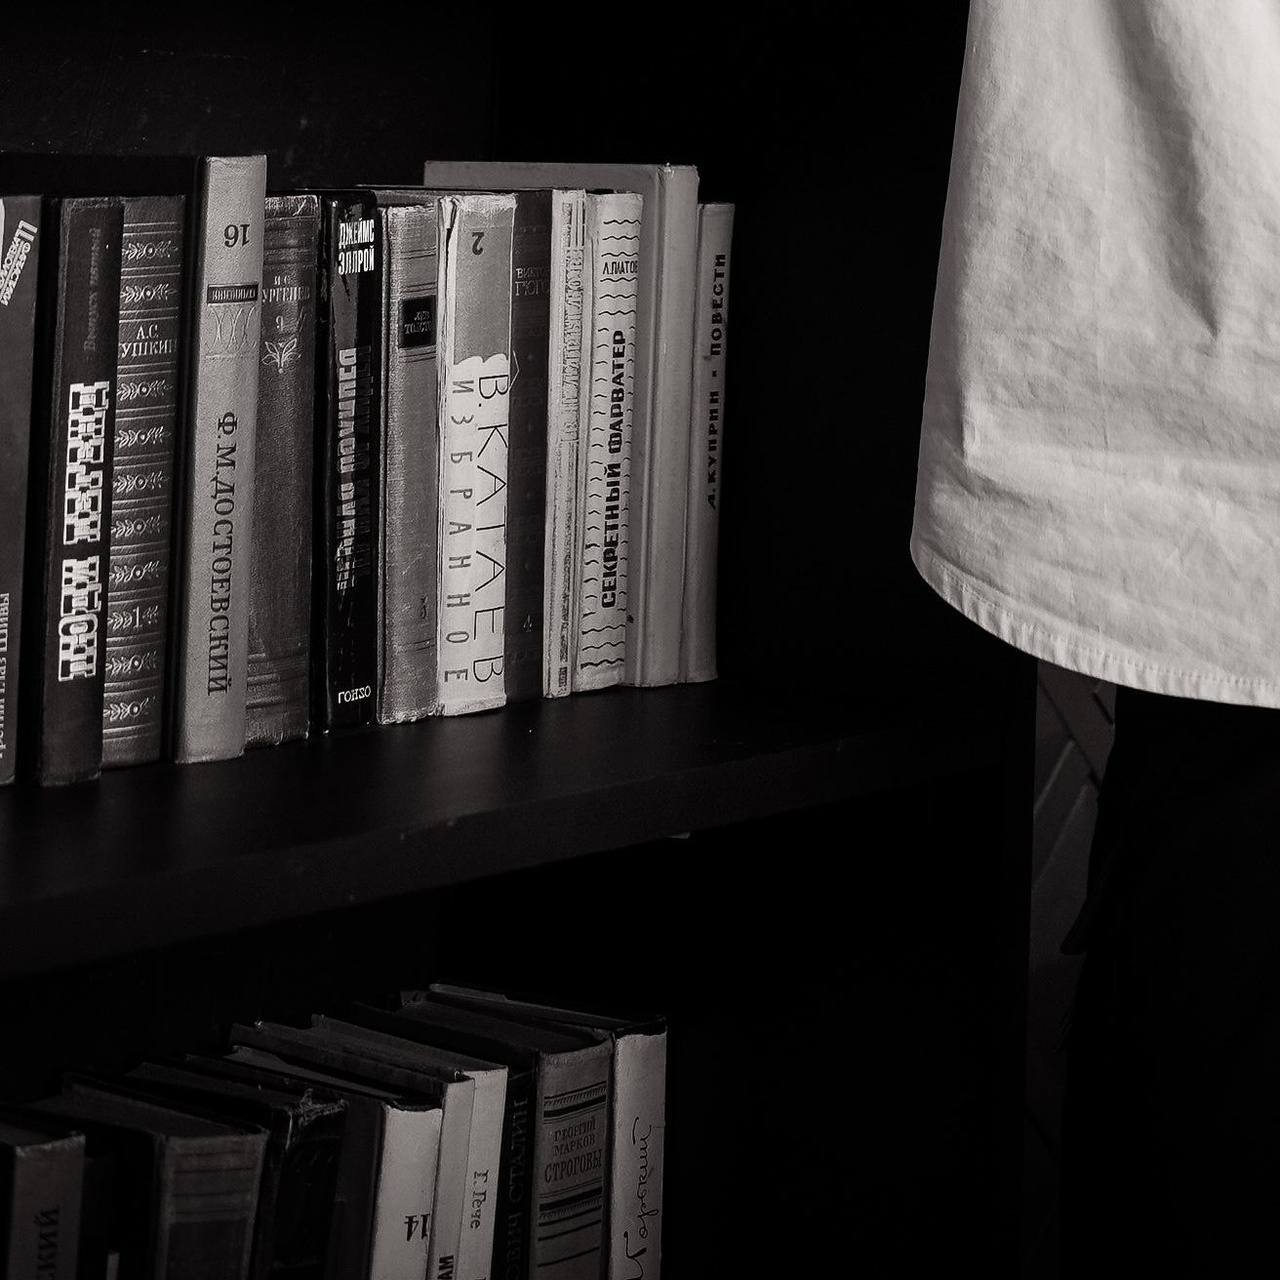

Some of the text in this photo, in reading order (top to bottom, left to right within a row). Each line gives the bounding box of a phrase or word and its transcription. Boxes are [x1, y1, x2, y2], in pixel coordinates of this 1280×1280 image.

[223, 223, 251, 248] 16
[338, 217, 375, 250] ДЖЕЙМС
[471, 231, 485, 256] 2
[338, 244, 375, 276] ЭЛЛРОЙ
[709, 253, 727, 357] ПОВЕСТИ
[707, 389, 721, 483] КУПРИН
[601, 329, 626, 610] СЕКРЕТНЫЙ ФАРВАТЕР
[552, 1133, 597, 1157] МАРКОВ
[553, 1115, 597, 1144] ГЕОРГИЙ
[544, 1148, 603, 1184] СТРОГОВЫ
[34, 1207, 60, 1280] КИЙ
